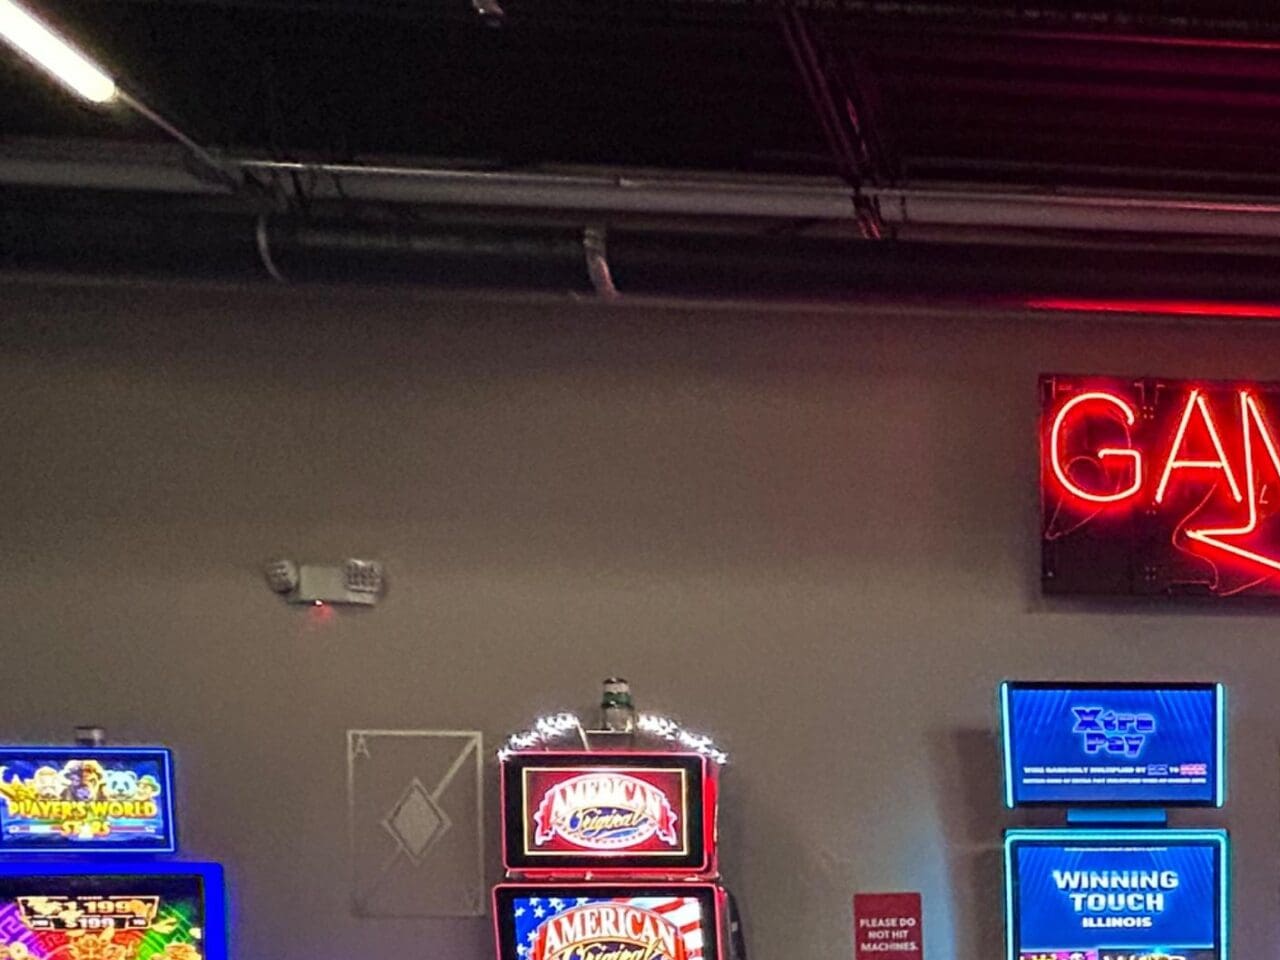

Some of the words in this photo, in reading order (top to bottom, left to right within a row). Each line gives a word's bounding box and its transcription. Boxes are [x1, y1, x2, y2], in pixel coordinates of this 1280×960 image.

[1071, 707, 1155, 732] Xtra
[1084, 732, 1145, 757] Pay
[8, 800, 87, 819] PLAYER'S
[90, 800, 158, 818] WORLD
[551, 776, 661, 823] AMERICAN
[566, 806, 648, 836] Original
[1052, 869, 1179, 890] WINNING
[1069, 892, 1164, 912] TOUCH
[860, 918, 897, 928] PLEASE
[899, 918, 916, 927] DO
[1082, 916, 1153, 928] ILLINOIS
[543, 907, 676, 960] AMERICAN
[868, 930, 890, 939] NOT
[891, 930, 909, 939] HIT
